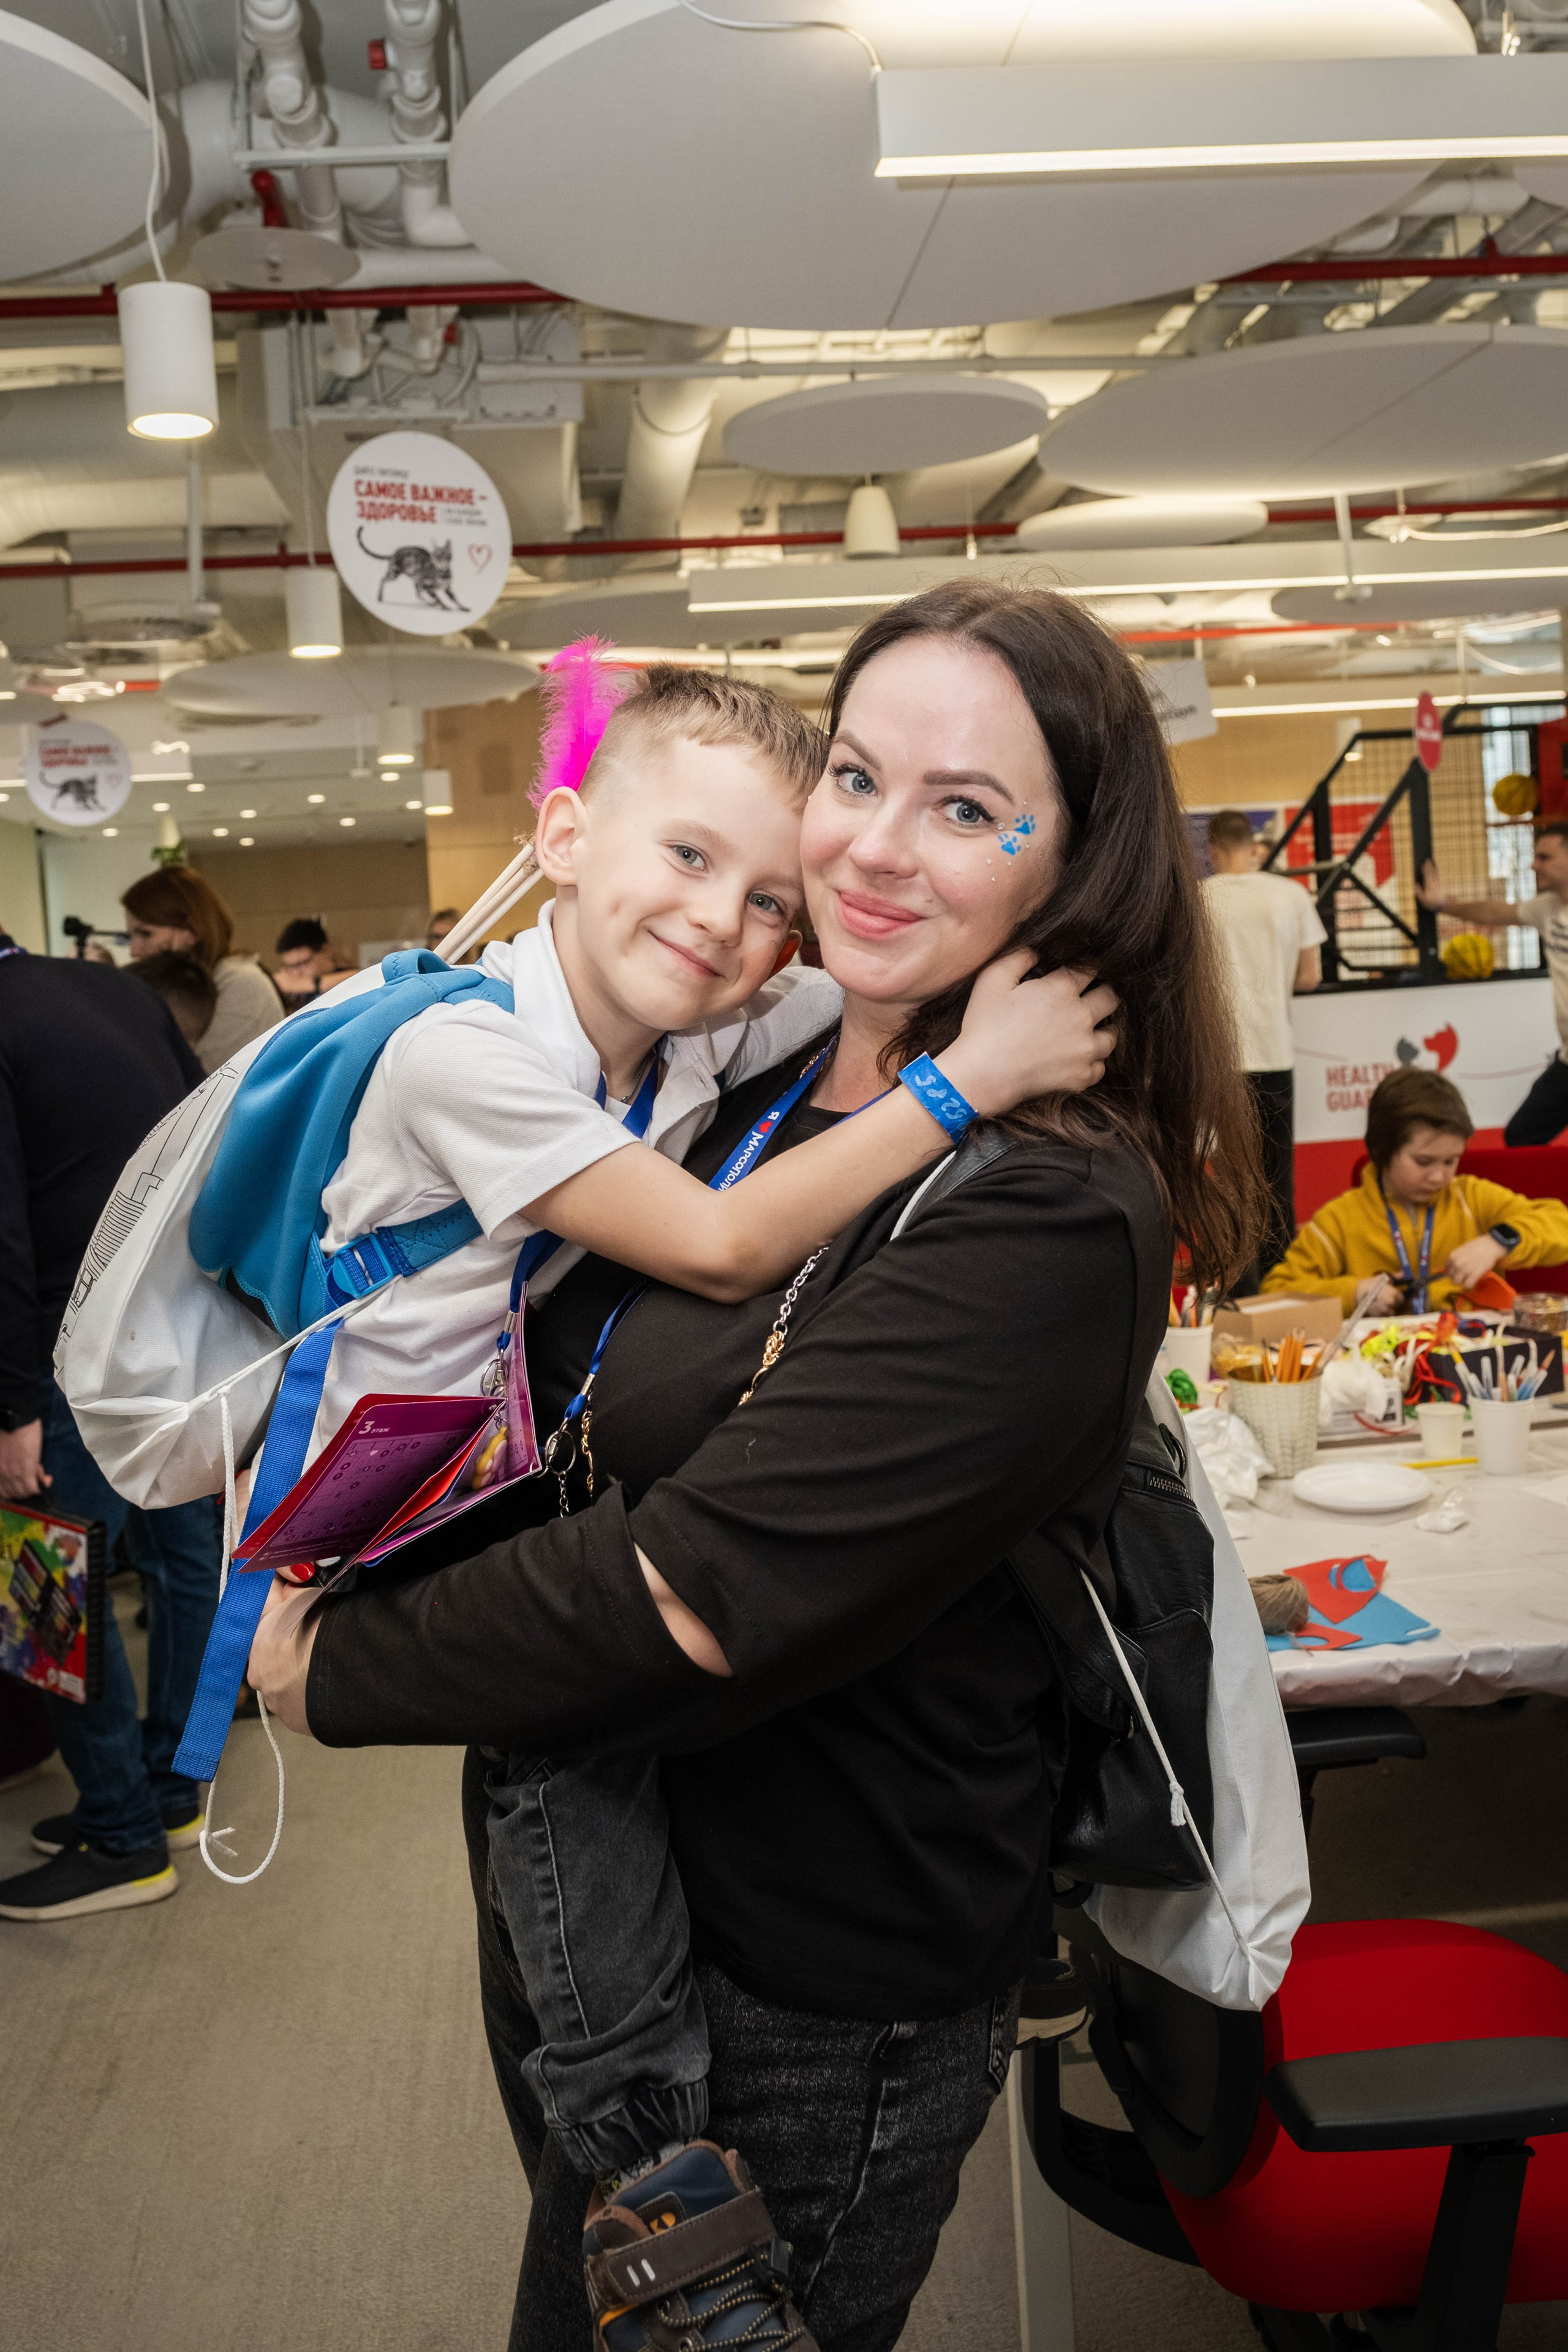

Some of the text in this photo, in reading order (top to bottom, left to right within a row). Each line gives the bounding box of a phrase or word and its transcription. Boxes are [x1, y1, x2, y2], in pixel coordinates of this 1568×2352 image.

[355, 479, 405, 500] САМОЕ
[410, 483, 474, 506] ВАЖНОЕ
[356, 500, 436, 524] ЗДОРОВЬЕ
[767, 1110, 780, 1120] Я
[358, 1420, 375, 1434] 3
